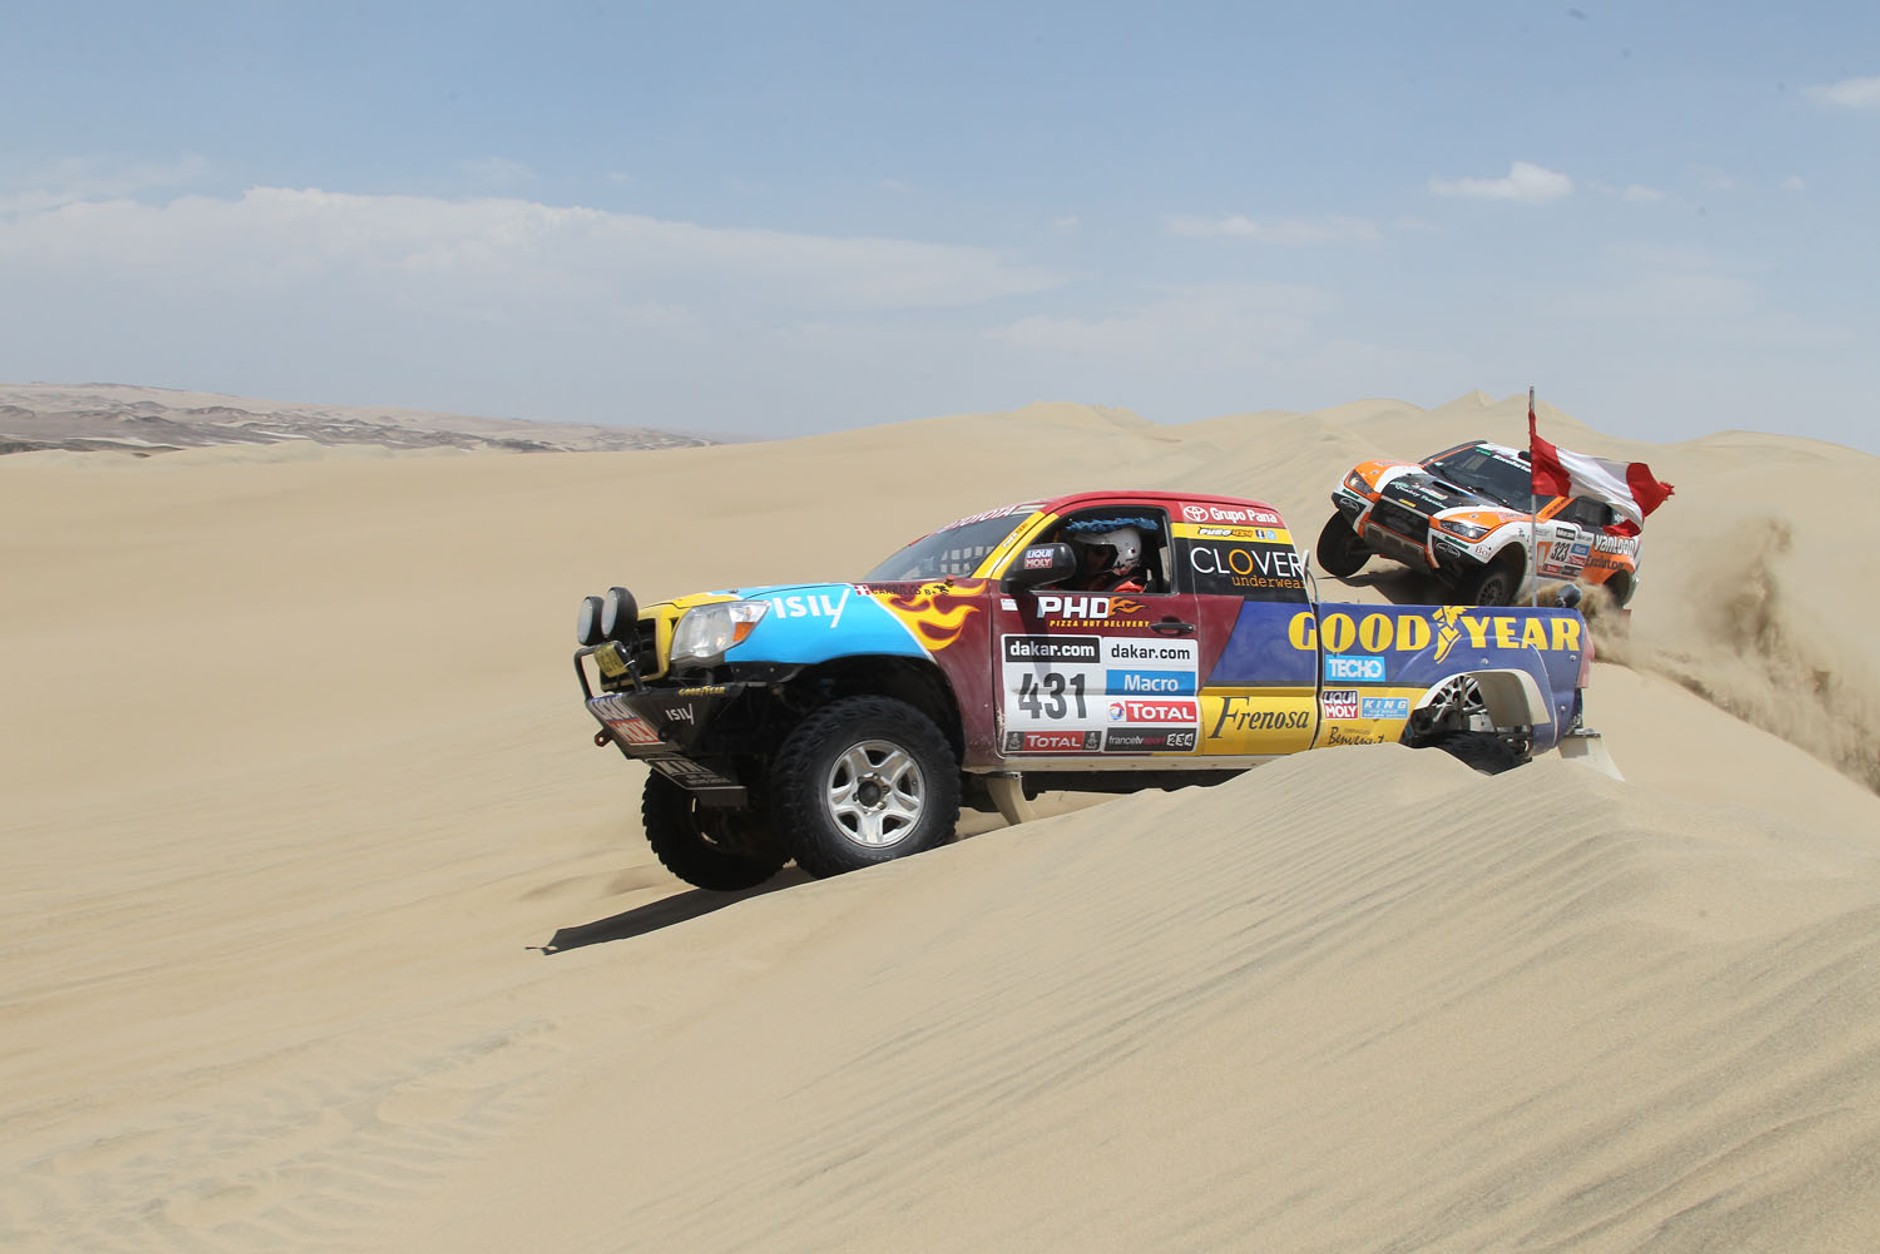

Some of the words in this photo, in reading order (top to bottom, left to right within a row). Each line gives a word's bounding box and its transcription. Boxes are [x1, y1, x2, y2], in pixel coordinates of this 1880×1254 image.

[1210, 507, 1246, 523] Grupo
[1247, 509, 1278, 524] Pana
[1026, 548, 1053, 558] LIQUI
[1551, 541, 1570, 562] 323
[1025, 558, 1052, 568] MOLY
[1190, 547, 1305, 578] CLOVER
[1036, 596, 1110, 619] PHD
[1288, 612, 1431, 653] GOOD
[1460, 616, 1580, 652] YEAR
[1010, 641, 1095, 657] dakar.com
[1111, 644, 1190, 660] dakar.com
[1328, 658, 1383, 678] TECHO
[1124, 674, 1179, 692] Macro
[1018, 672, 1087, 720] 431
[1323, 691, 1357, 704] LIQUI
[1364, 700, 1408, 709] KING
[1128, 703, 1195, 720] TOTAL
[1207, 696, 1310, 739] Frenosa
[1325, 704, 1358, 718] MOLY
[1028, 735, 1082, 748] TOTAL
